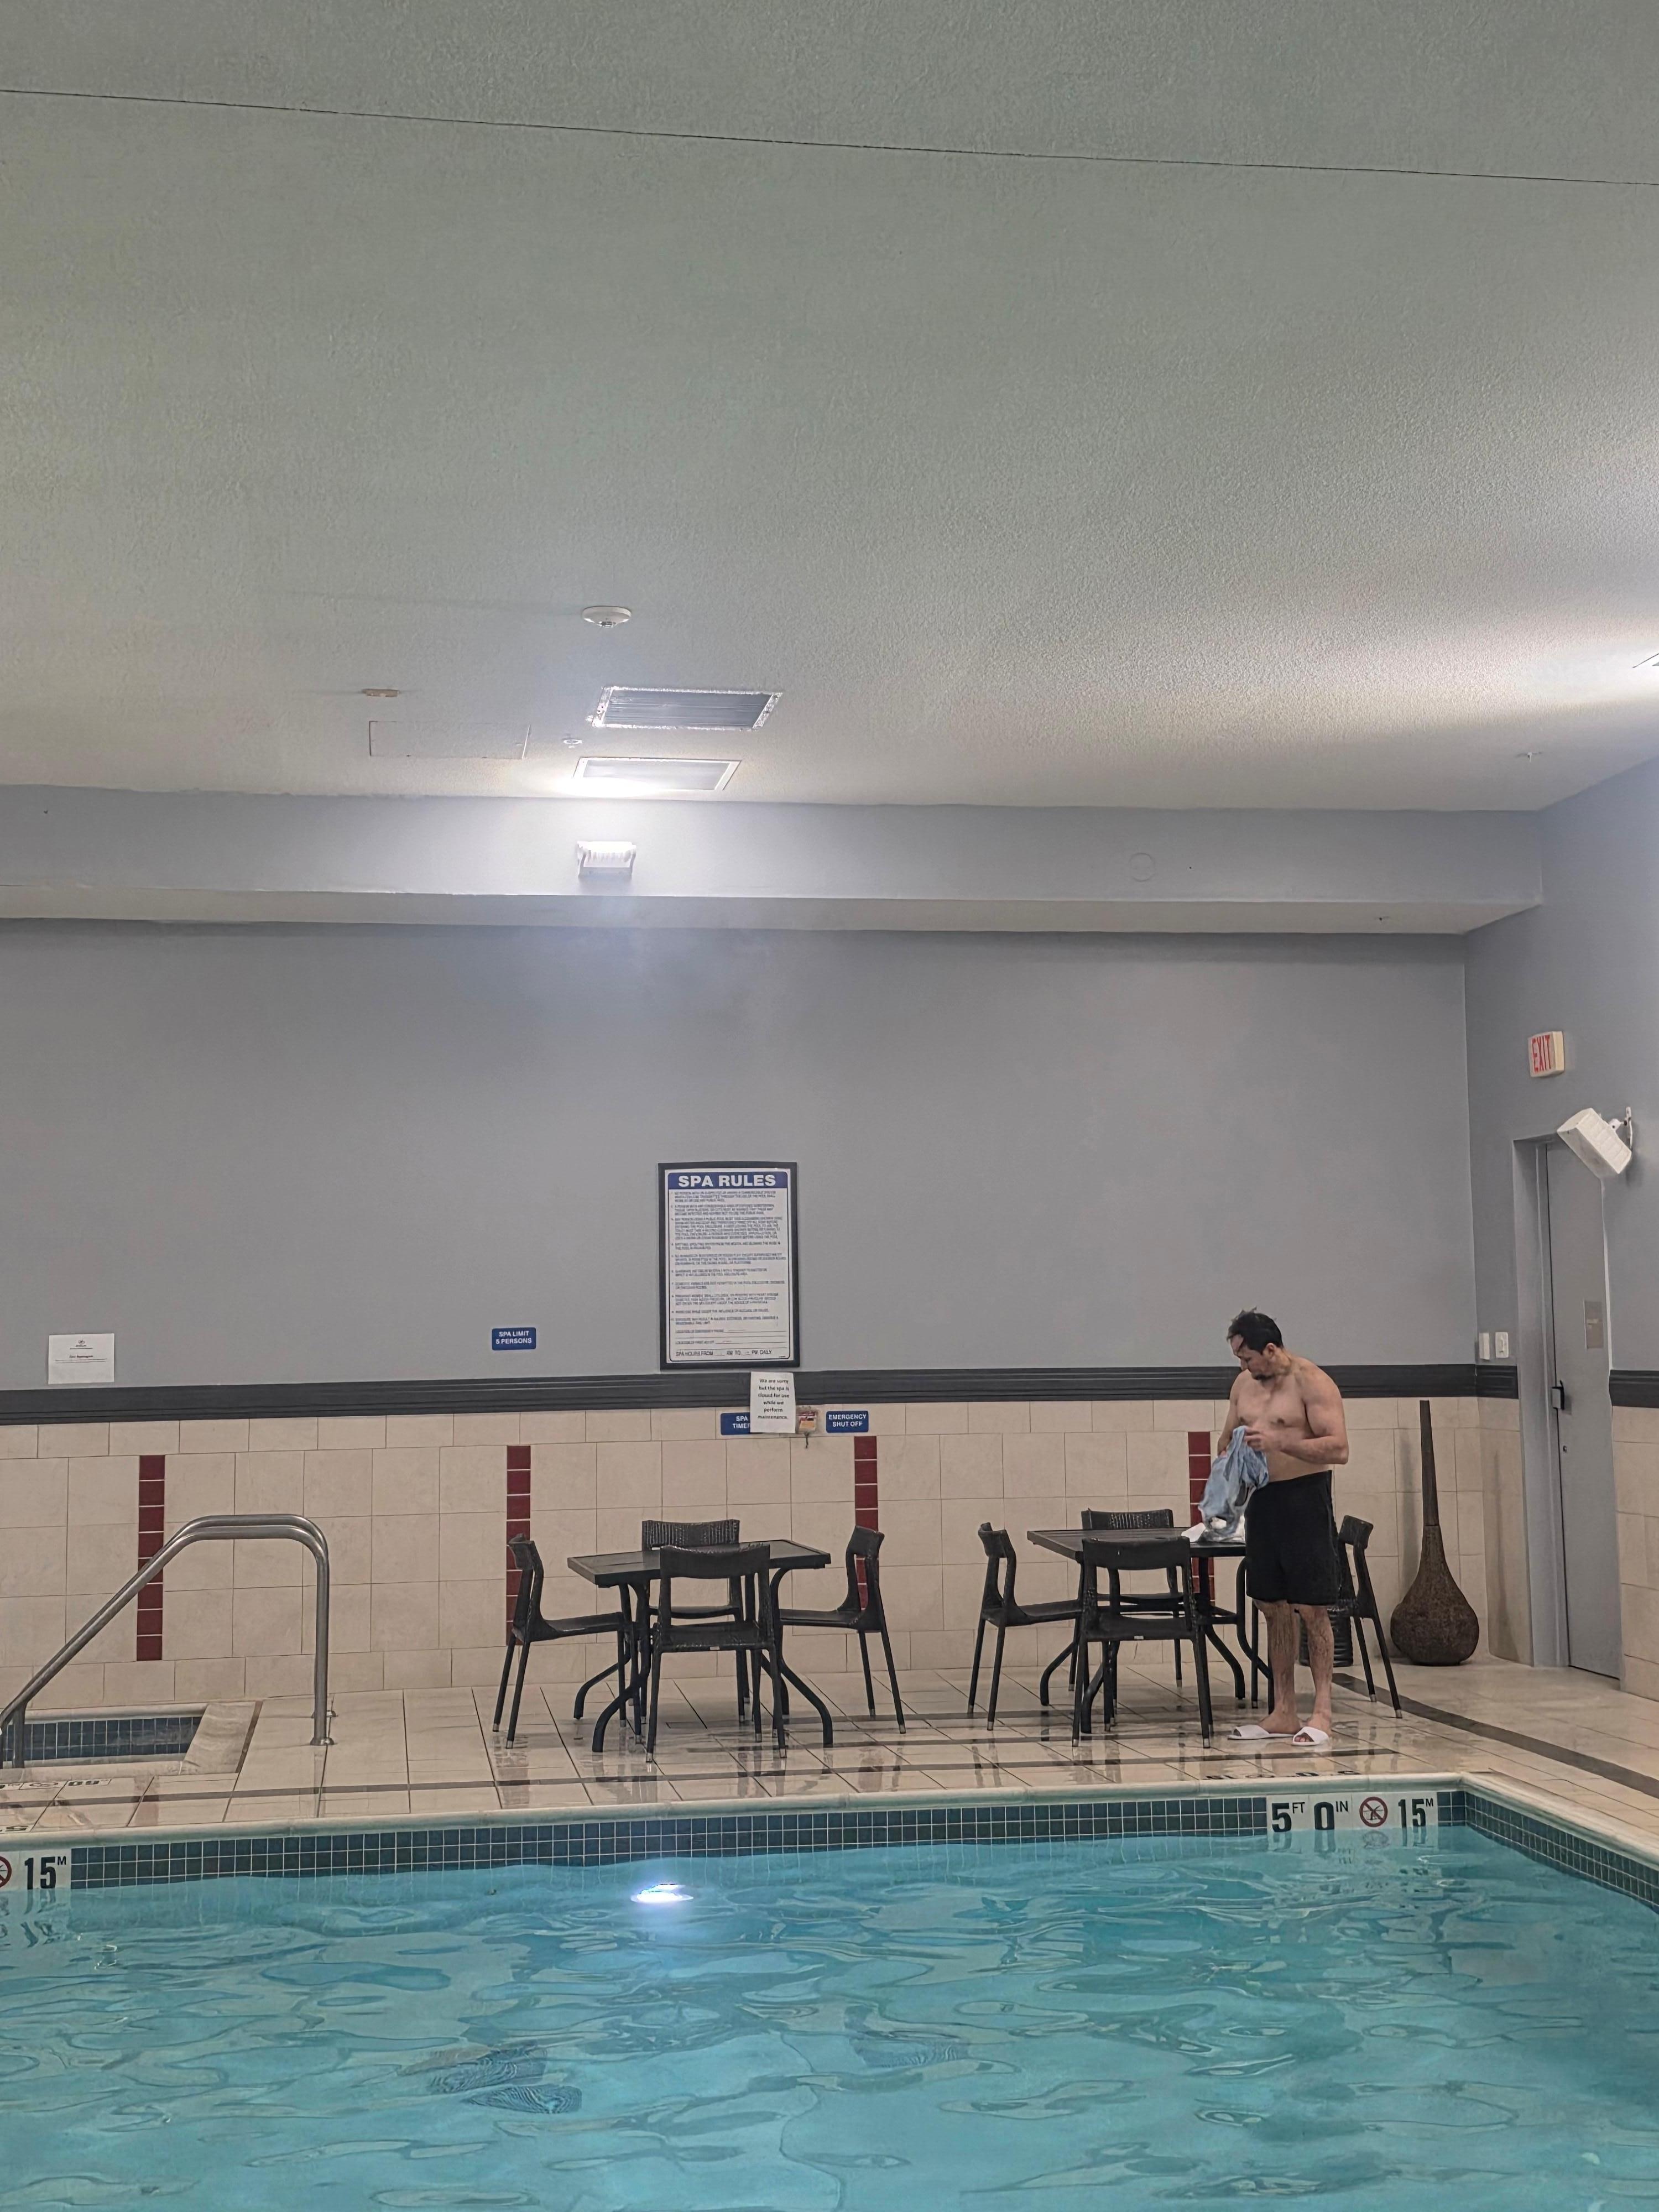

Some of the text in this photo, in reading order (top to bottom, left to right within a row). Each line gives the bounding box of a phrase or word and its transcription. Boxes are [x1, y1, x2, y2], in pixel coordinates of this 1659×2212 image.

[1531, 1035, 1551, 1073] EXIT
[678, 1175, 776, 1187] SPA RULES
[1272, 1798, 1433, 1833] 5 FT 0 IN 15 M
[24, 1856, 66, 1890] 15 M
